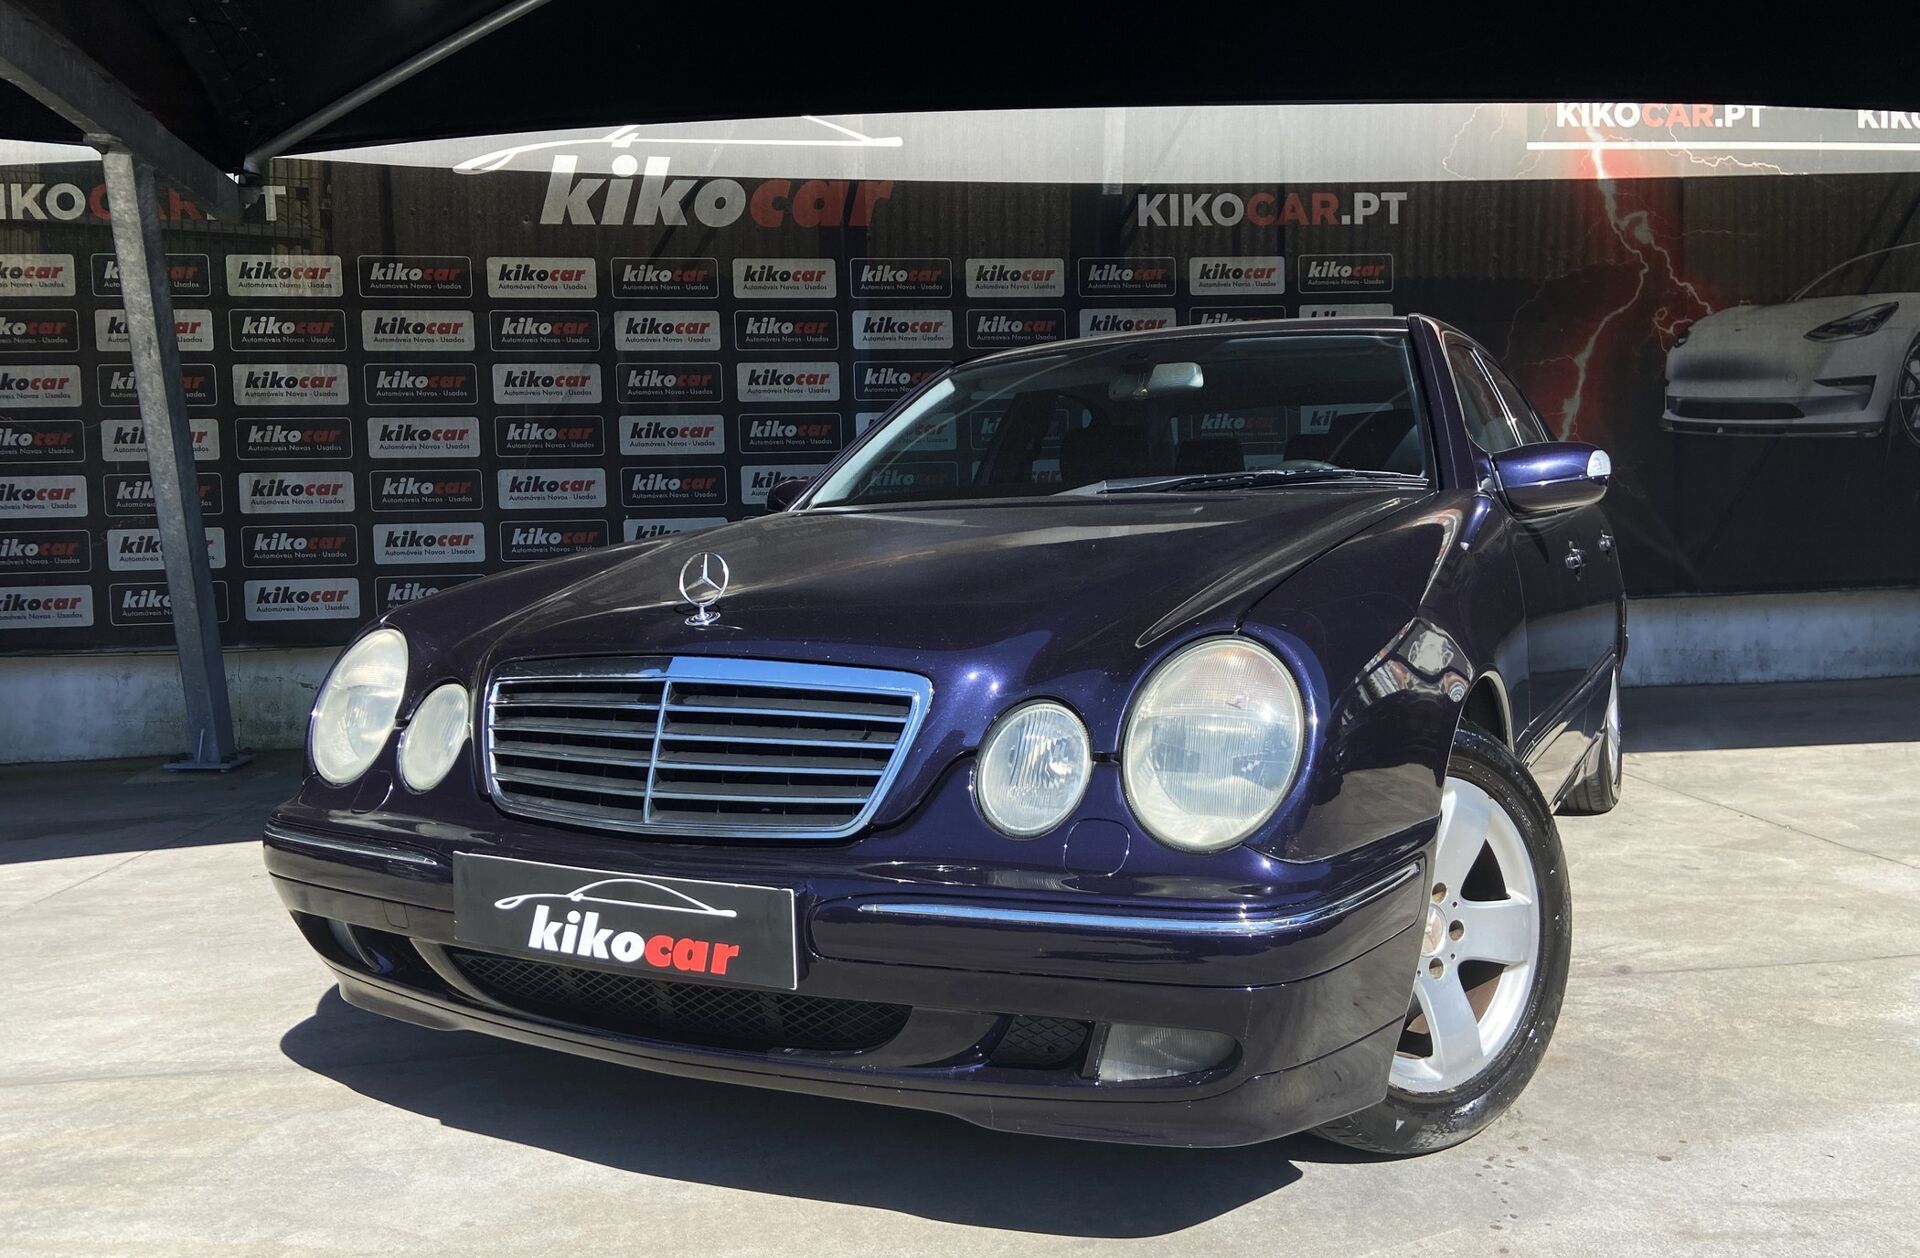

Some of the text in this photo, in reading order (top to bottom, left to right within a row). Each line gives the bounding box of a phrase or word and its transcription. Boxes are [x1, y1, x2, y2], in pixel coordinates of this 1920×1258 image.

[1556, 103, 1767, 128] KIKOCAR.PT
[540, 154, 893, 228] kikocar
[1138, 191, 1408, 227] KIKOCAR.PT
[0, 261, 62, 279] kocar
[239, 262, 331, 279] kikocar
[370, 263, 460, 280] kikocar
[498, 264, 585, 281] kikocar
[623, 264, 707, 281] kikocar
[744, 265, 826, 281] kikocar
[861, 265, 941, 281] kikocar
[976, 265, 1054, 281] kikocar
[1089, 264, 1165, 280] kikocar
[1199, 263, 1275, 279] kikocar
[1309, 261, 1383, 277] kikocar
[0, 317, 66, 334] kocar
[242, 317, 334, 334] kikocar
[373, 317, 463, 334] kikocar
[501, 317, 588, 334] kikocar
[625, 317, 709, 334] kikocar
[746, 317, 828, 333] kikocar
[863, 316, 943, 333] kikocar
[978, 315, 1056, 332] kikocar
[1090, 314, 1166, 331] kikocar
[0, 372, 69, 390] kocar
[245, 371, 337, 388] kikocar
[376, 370, 466, 388] kikocar
[504, 370, 590, 387] kikocar
[628, 369, 712, 386] kikocar
[748, 369, 830, 385] kikocar
[248, 425, 340, 442] kikocar
[379, 424, 468, 441] kikocar
[506, 423, 593, 440] kikocar
[630, 422, 714, 438] kikocar
[750, 420, 831, 437] kikocar
[251, 479, 343, 496] kikocar
[382, 477, 471, 494] kikocar
[509, 475, 595, 492] kikocar
[632, 473, 716, 490] kikocar
[0, 483, 75, 501] ikocar
[254, 532, 345, 550] kikocar
[385, 530, 473, 547] kikocar
[511, 527, 597, 545] kikocar
[0, 538, 78, 556] ikocar
[0, 592, 81, 611] ikocar
[257, 586, 348, 604] kikocar
[528, 904, 740, 975] kikocar
